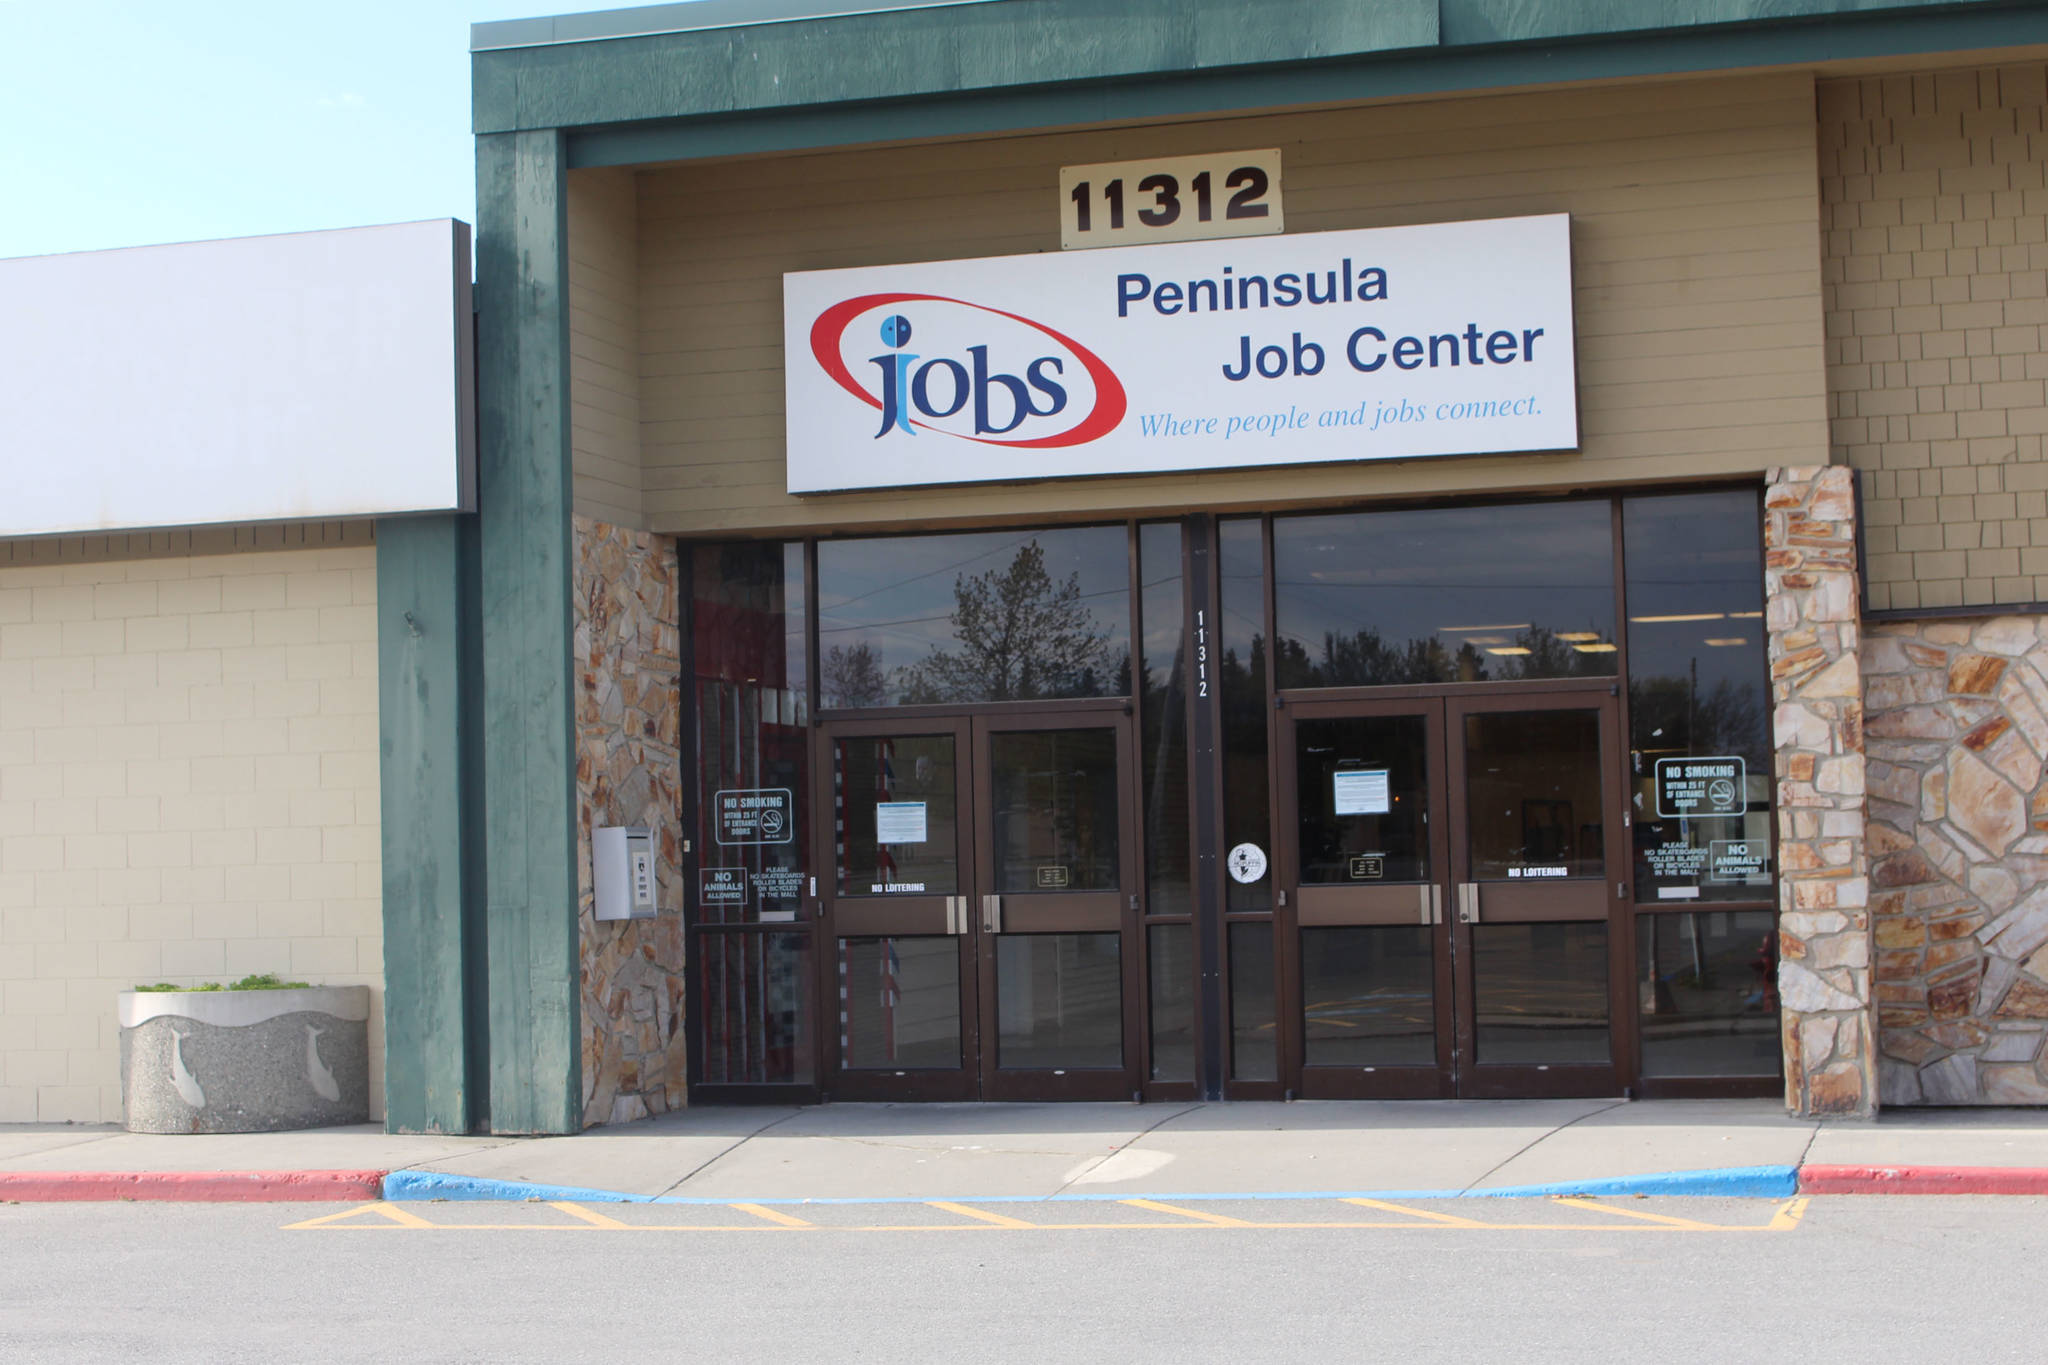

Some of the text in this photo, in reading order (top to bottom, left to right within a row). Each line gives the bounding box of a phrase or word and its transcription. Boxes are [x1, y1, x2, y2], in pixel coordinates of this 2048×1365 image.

[1070, 166, 1270, 232] 11312
[1117, 258, 1388, 318] Peninsula
[1222, 324, 1544, 382] Job Center
[869, 314, 1067, 439] jobs
[1140, 394, 1542, 440] Where people and jobs connect.
[1198, 610, 1207, 697] 11312
[1666, 765, 1735, 778] NO SMOKING
[724, 796, 783, 808] NO SMOKING
[1728, 845, 1748, 855] NO
[1715, 856, 1762, 865] ANIMALS
[1508, 867, 1568, 877] NO LOITERING
[1719, 866, 1759, 874] ALLOWED
[714, 872, 732, 882] NO
[704, 883, 744, 891] ANIMALS
[871, 882, 925, 893] NO LOITERING
